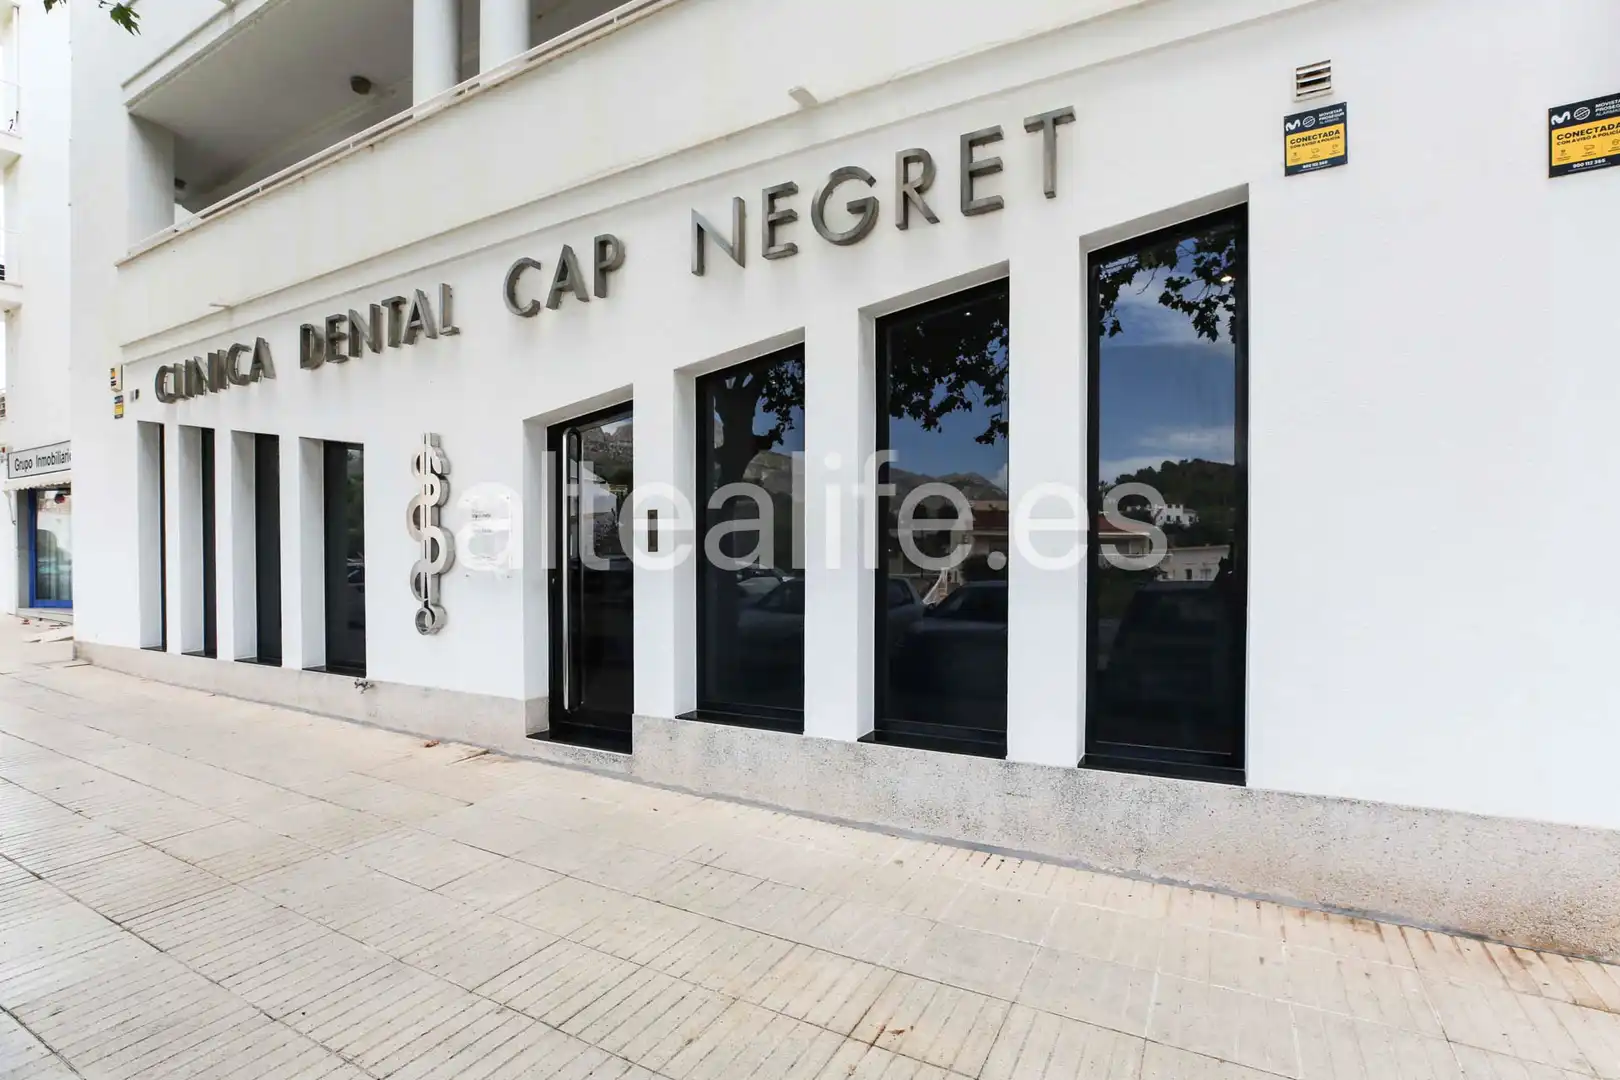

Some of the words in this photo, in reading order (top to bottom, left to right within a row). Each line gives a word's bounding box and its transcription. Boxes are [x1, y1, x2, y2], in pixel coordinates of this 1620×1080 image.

[1290, 129, 1340, 145] CONECTADA
[1557, 122, 1620, 140] CONECTADA
[154, 336, 277, 404] CLINICA
[300, 282, 461, 370] DENTAL
[502, 233, 626, 318] CAP
[690, 106, 1076, 277] NEGRET
[14, 456, 33, 472] Grupo
